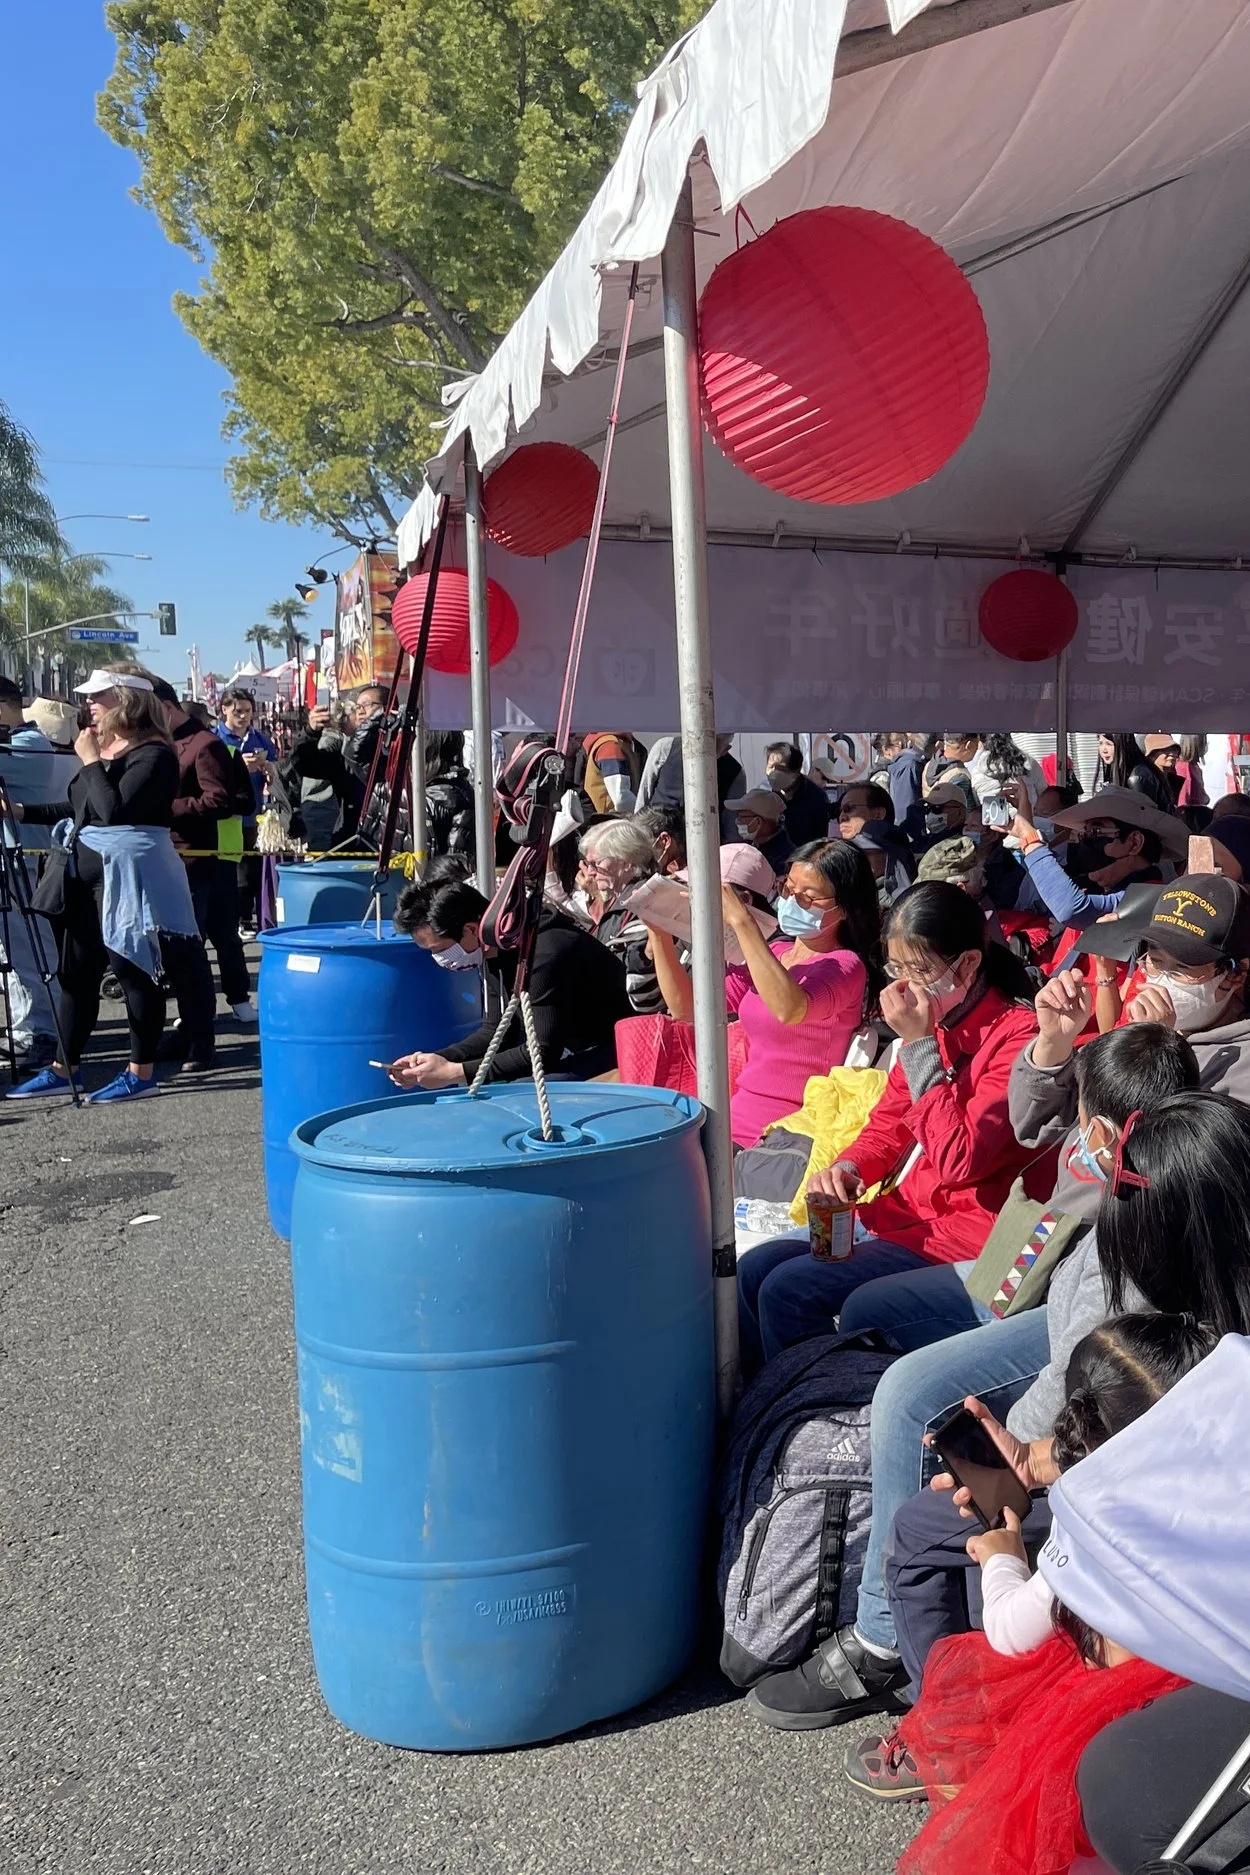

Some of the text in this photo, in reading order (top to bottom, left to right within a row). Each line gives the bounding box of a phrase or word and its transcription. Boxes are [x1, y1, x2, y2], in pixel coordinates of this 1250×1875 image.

[1162, 890, 1217, 917] YELLOWSTONE
[1177, 918, 1206, 936] RANCH
[826, 1452, 860, 1462] adidas
